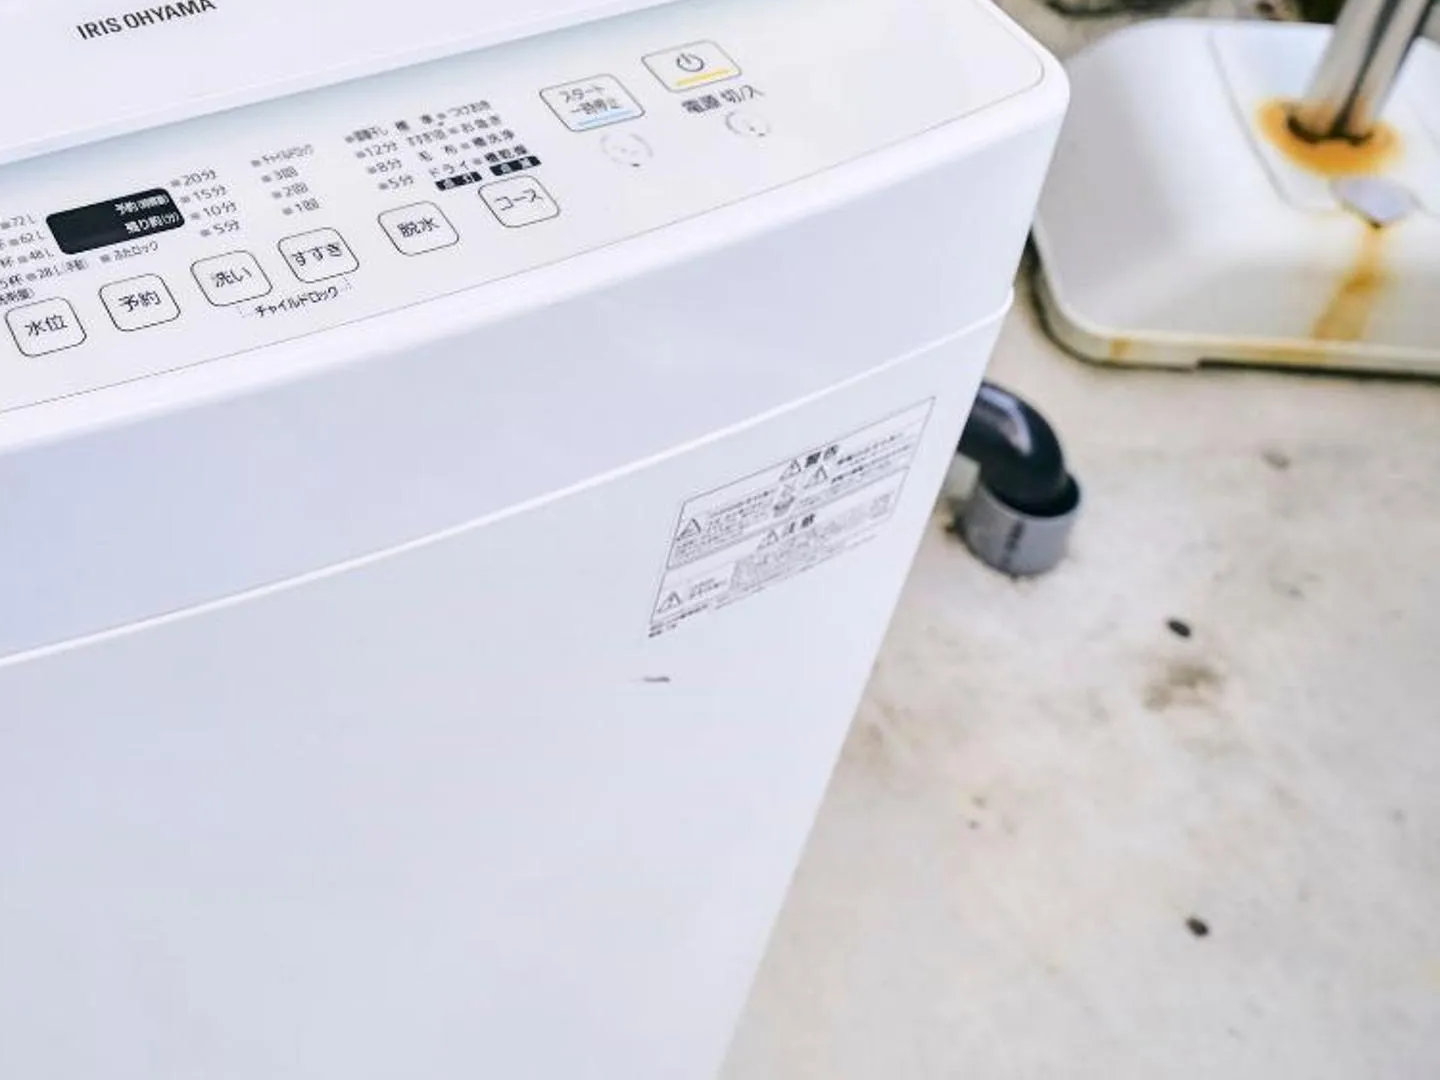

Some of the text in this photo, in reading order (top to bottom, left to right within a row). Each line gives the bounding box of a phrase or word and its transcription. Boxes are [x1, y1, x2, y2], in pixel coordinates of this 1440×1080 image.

[76, 17, 123, 40] IRIS
[495, 187, 543, 212] コース
[397, 216, 441, 238] 脱水
[291, 242, 343, 266] すすぎ
[213, 266, 255, 288] 洗い
[118, 289, 161, 313] 予約
[255, 286, 339, 317] チャイルドロック
[24, 313, 68, 336] 水位
